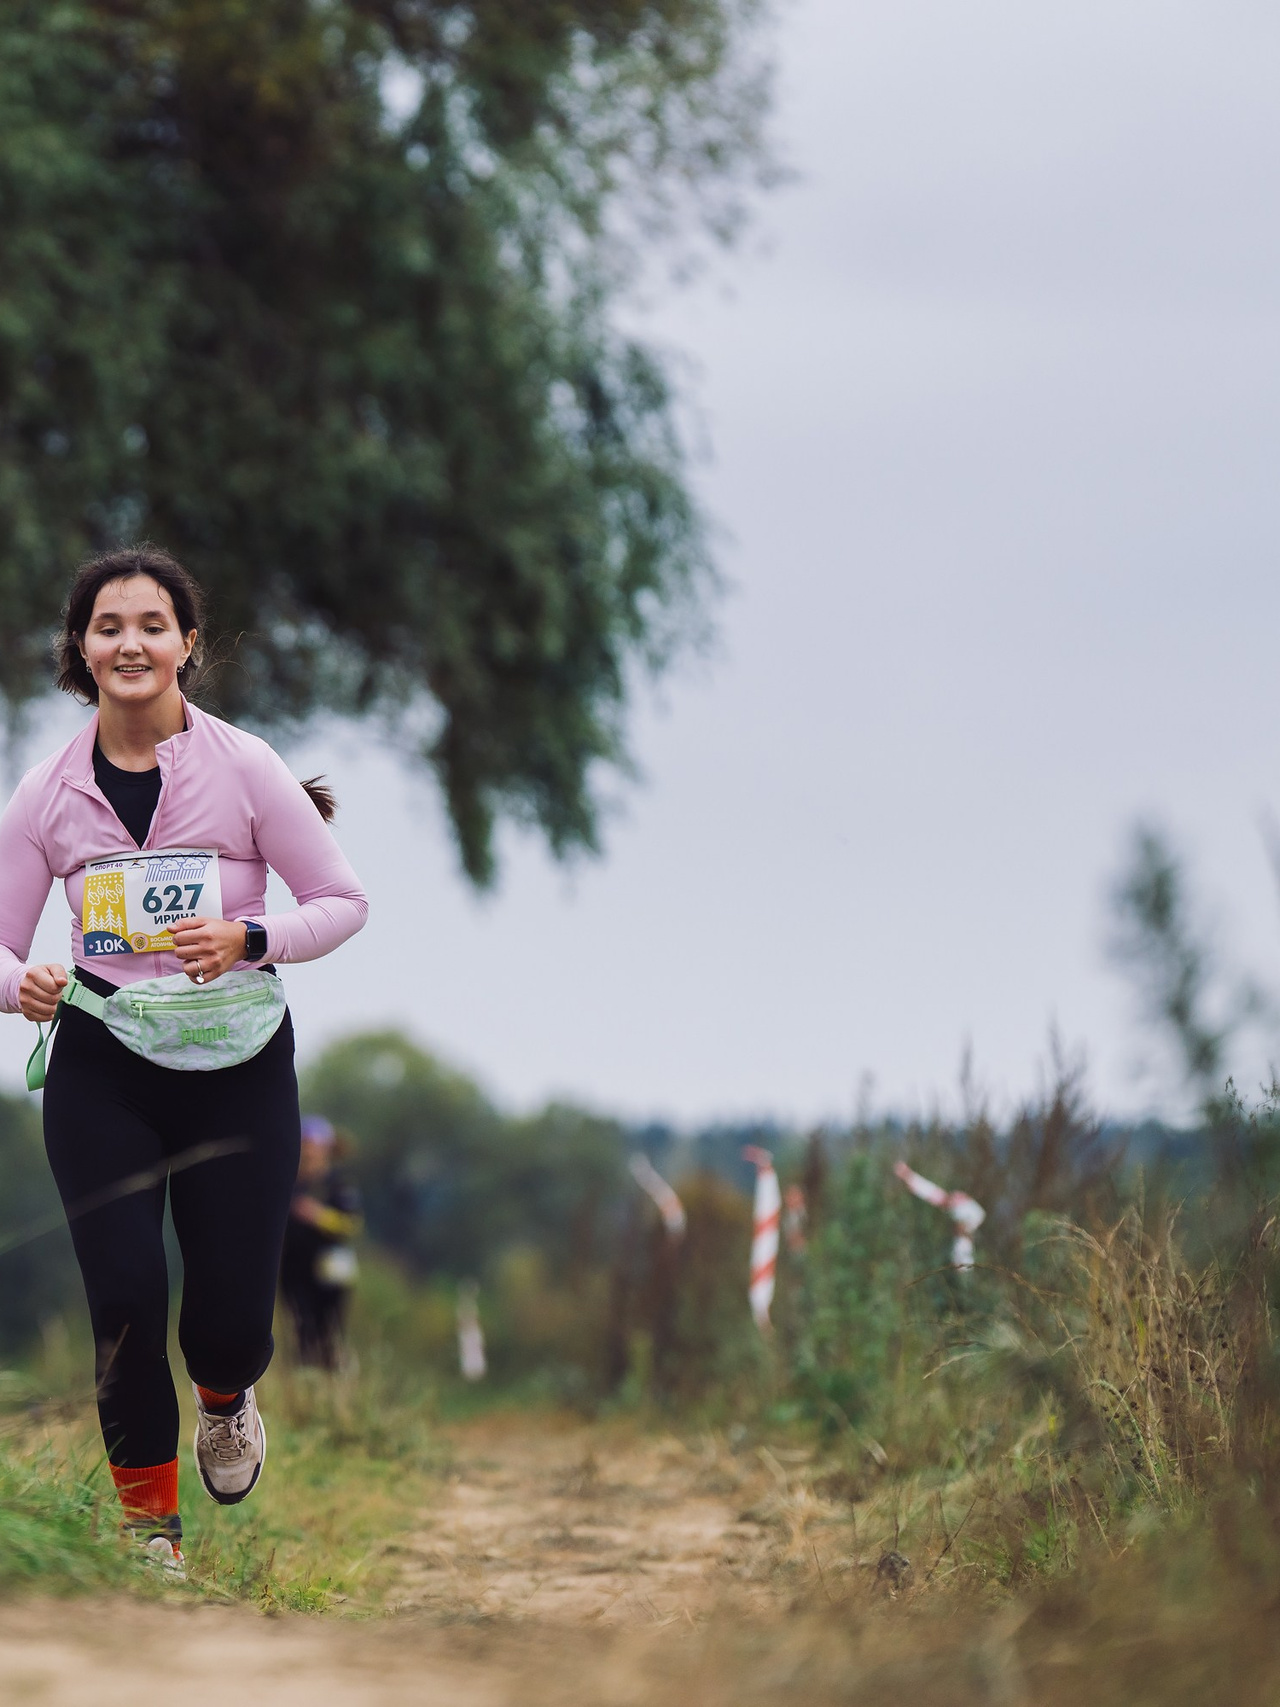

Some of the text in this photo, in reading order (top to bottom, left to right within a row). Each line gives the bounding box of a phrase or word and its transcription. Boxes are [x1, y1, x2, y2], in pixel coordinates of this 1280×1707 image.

[94, 863, 114, 871] СПОРТ
[142, 883, 205, 914] 627
[94, 938, 125, 953] 10K
